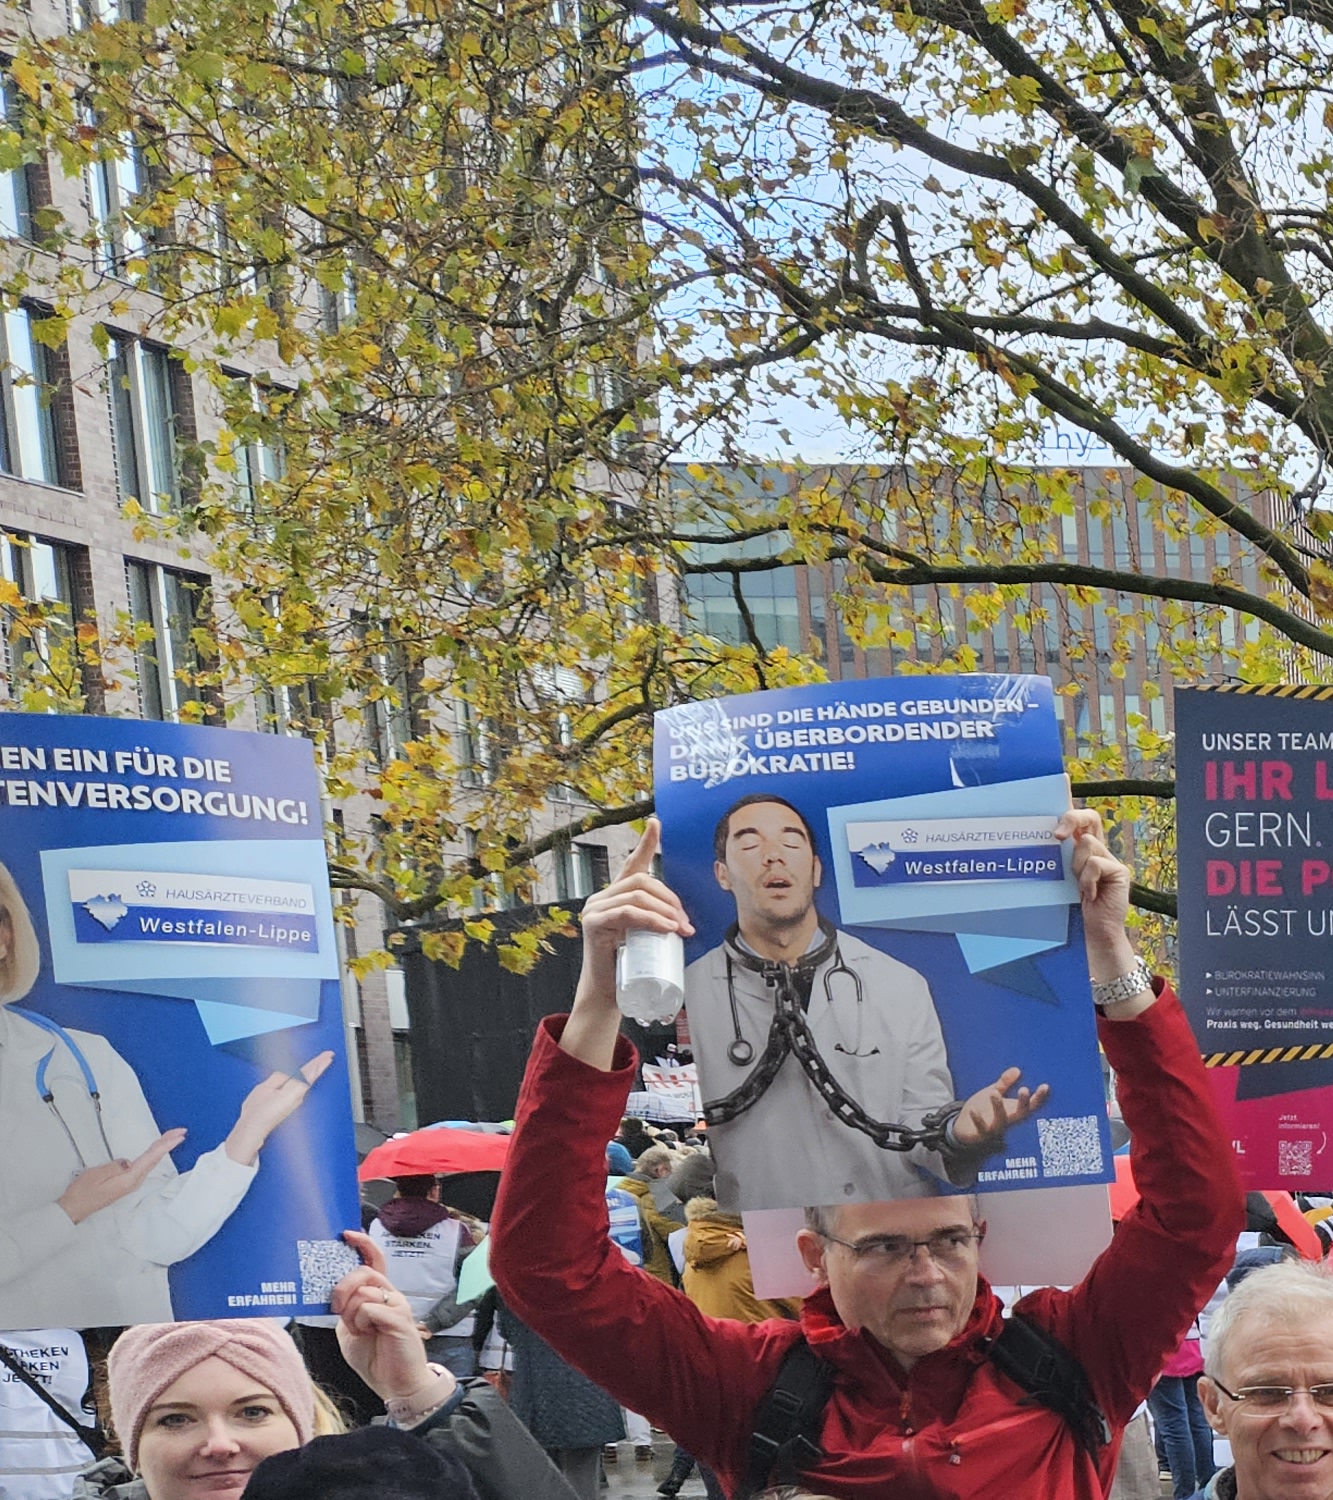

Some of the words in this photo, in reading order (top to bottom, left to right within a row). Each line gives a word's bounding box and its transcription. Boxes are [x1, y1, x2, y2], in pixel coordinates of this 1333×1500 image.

[669, 722, 725, 739] UNS
[727, 712, 772, 731] SIND
[778, 708, 814, 724] DIE
[818, 700, 896, 721] HÄNDE
[901, 699, 1023, 716] GEBUNDEN
[670, 736, 748, 760] DANK
[755, 720, 994, 749] ÜBERBORDENDER
[1202, 733, 1271, 751] UNSER
[1278, 733, 1333, 750] TEAM
[54, 749, 108, 773] EIN
[115, 746, 177, 778] FÜR
[183, 758, 231, 783] DIE
[670, 752, 855, 782] BÜROKRATIE!
[1205, 761, 1293, 800] IHR
[0, 780, 308, 825] ENVERSORGUNG!
[926, 829, 1052, 843] HAUSÄRZTEVERBAND
[1205, 812, 1322, 847] GERN.
[905, 858, 1057, 876] Westfalen-Lippe
[1206, 860, 1283, 896] DIE
[166, 889, 307, 909] HAUSÄRZTEVERBAND
[140, 917, 311, 943] Westfalen-Lippe
[1207, 905, 1297, 936] LÄSST
[978, 1168, 1038, 1182] ERFAHREN!
[1006, 1156, 1036, 1168] MEHR
